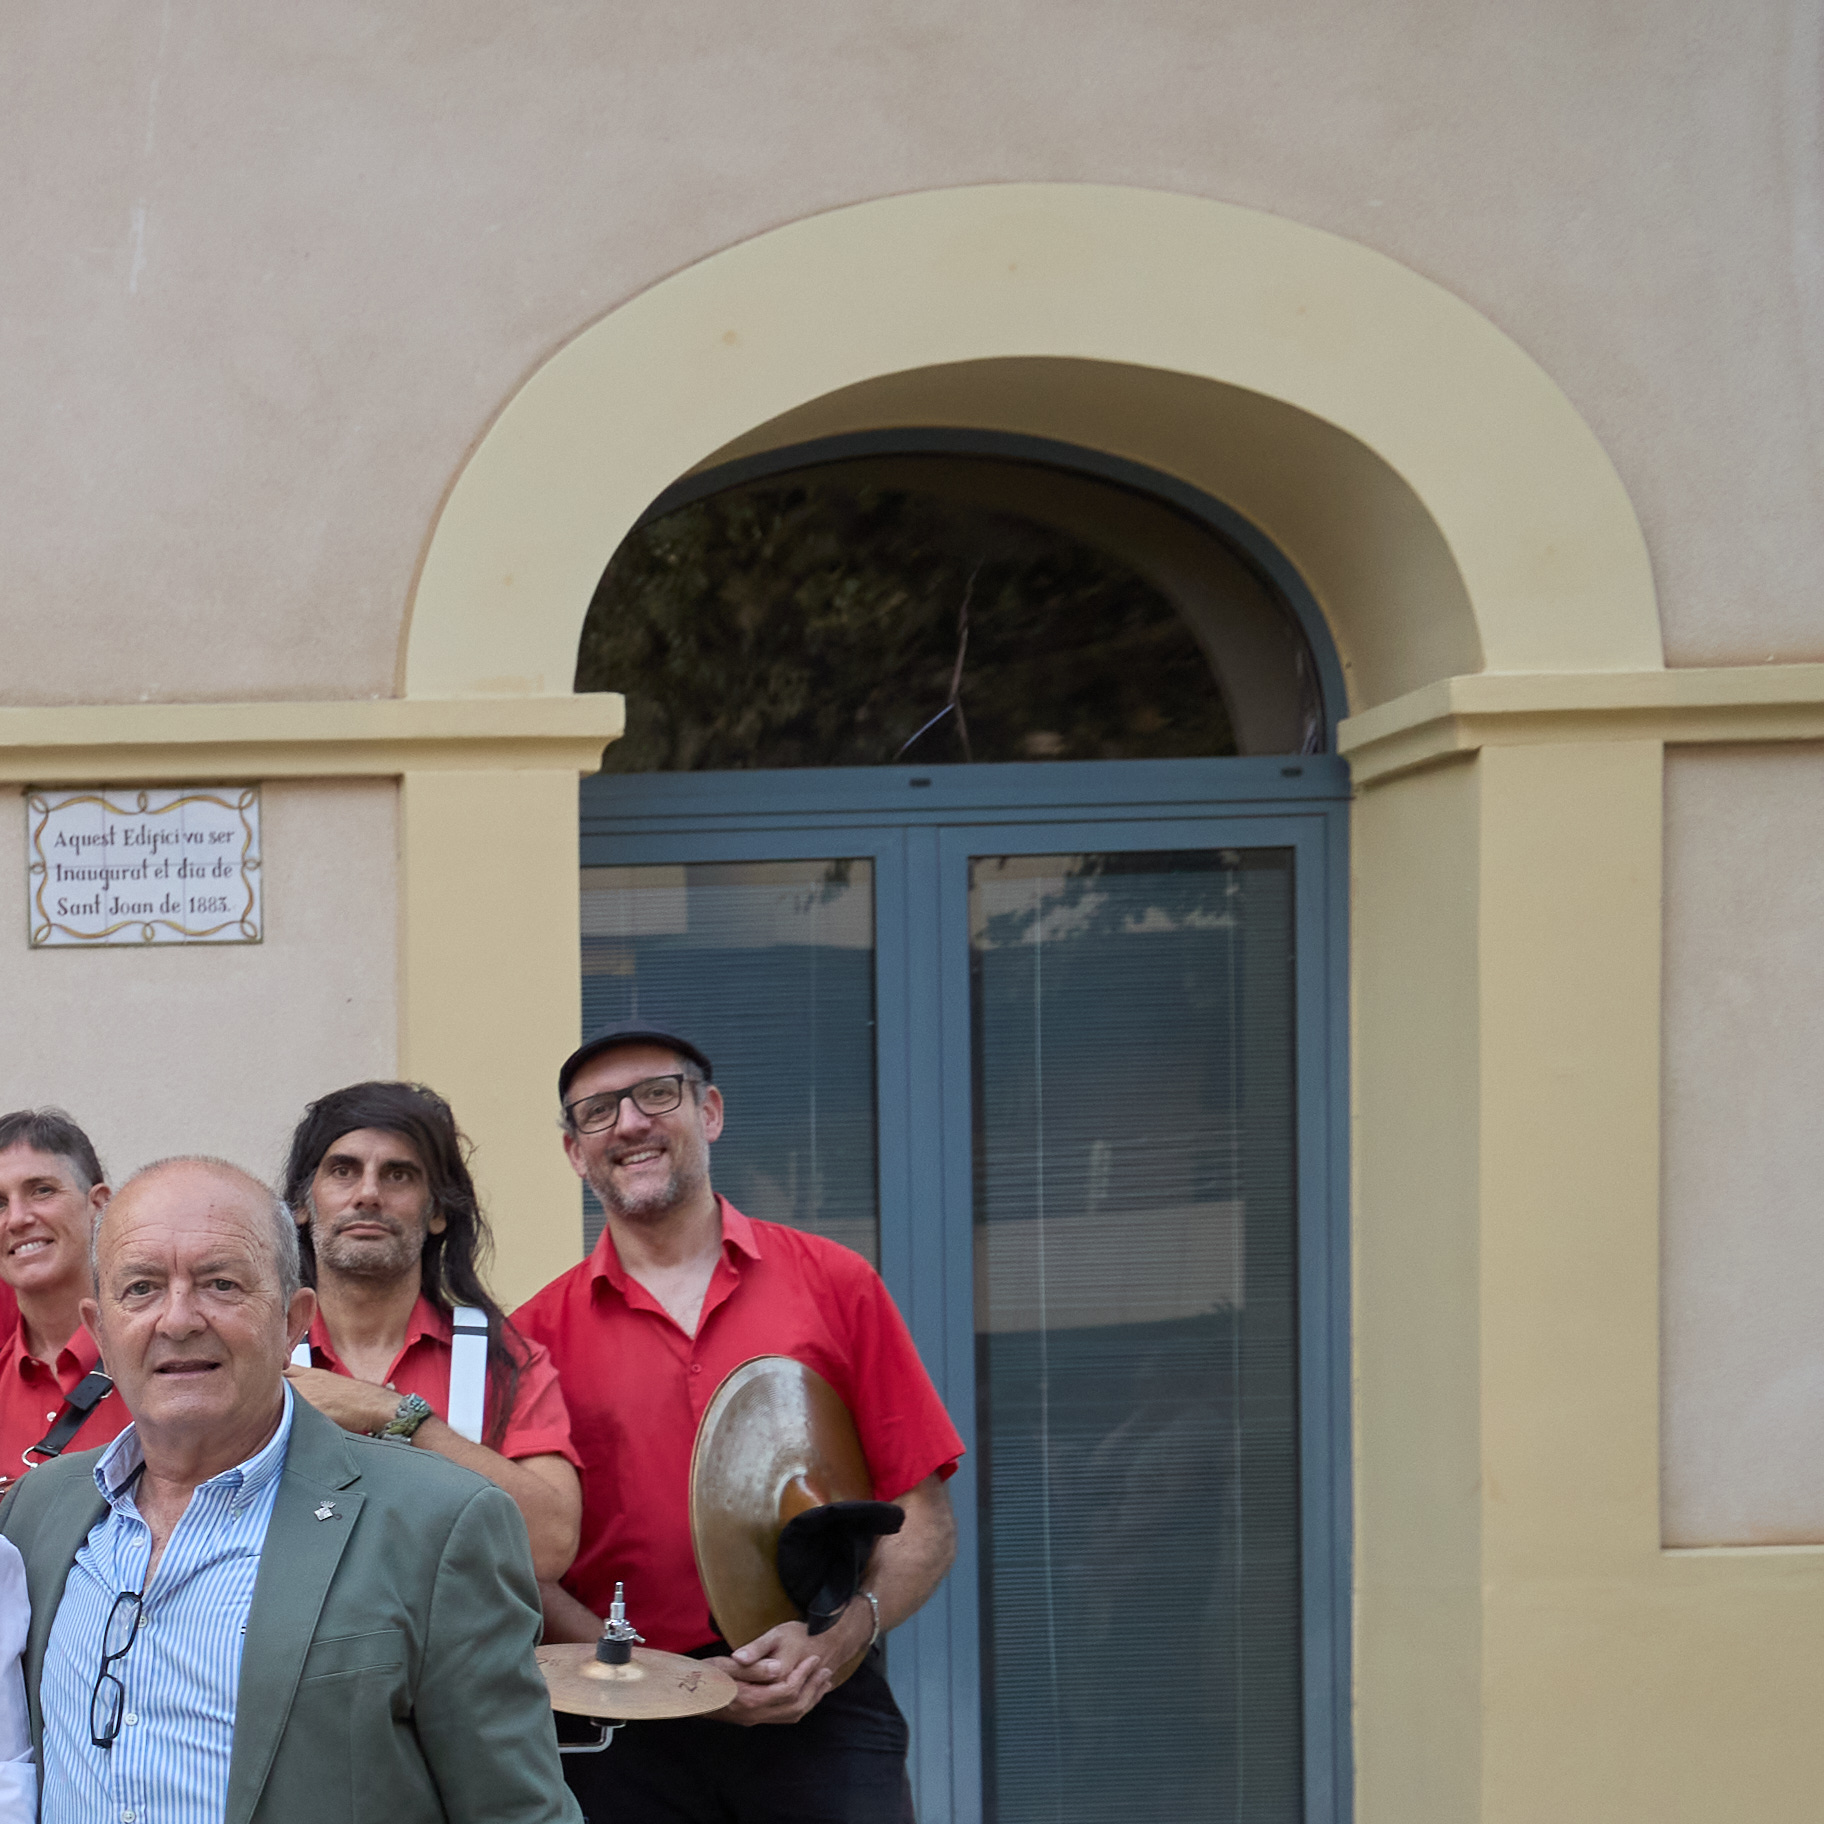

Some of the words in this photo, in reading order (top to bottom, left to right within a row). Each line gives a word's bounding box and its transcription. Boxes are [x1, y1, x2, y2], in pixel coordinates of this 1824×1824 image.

[54, 824, 116, 856] Aquest
[124, 824, 179, 855] Edifici
[183, 831, 204, 844] va
[208, 830, 235, 845] ser
[56, 858, 148, 891] Inaugurat
[154, 857, 169, 879] el
[177, 856, 205, 879] dia
[212, 856, 233, 879] de
[57, 893, 101, 916] Sant
[109, 896, 153, 915] Joan
[160, 892, 181, 914] de
